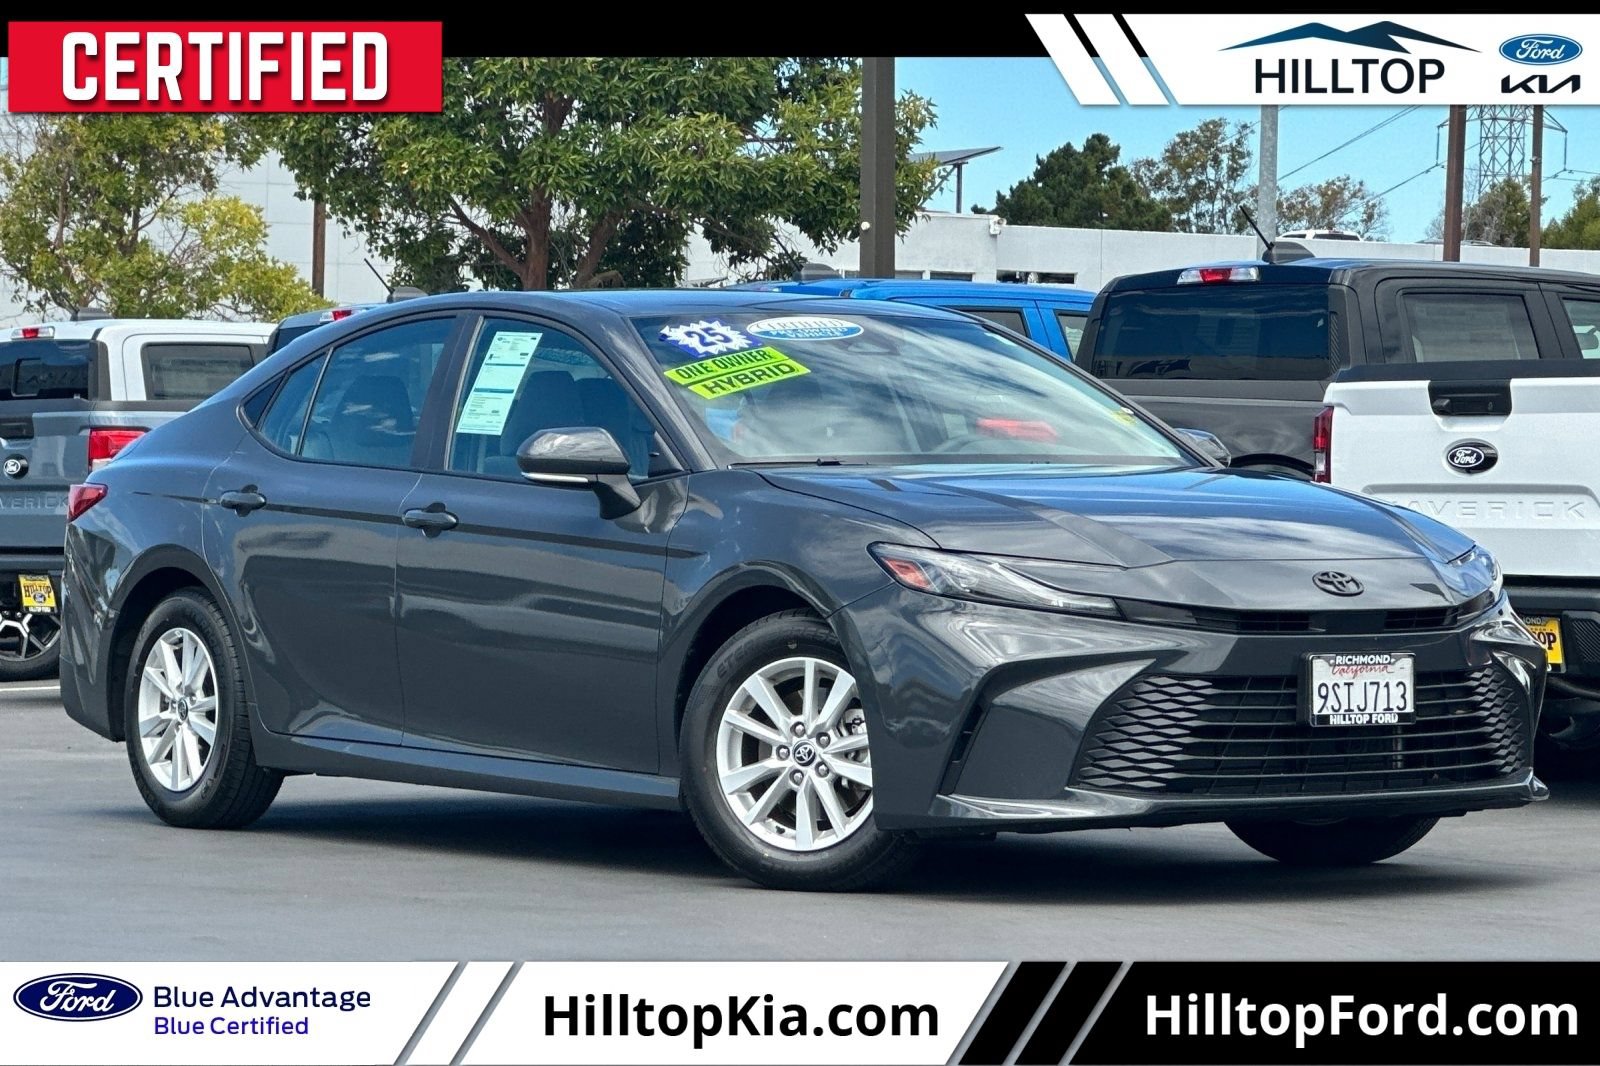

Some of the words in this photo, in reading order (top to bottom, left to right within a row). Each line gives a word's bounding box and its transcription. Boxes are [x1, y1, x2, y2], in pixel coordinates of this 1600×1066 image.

[683, 326, 734, 348] 25
[674, 363, 714, 380] ONE
[717, 350, 774, 371] OWNER
[701, 362, 798, 395] HYBRID
[1453, 449, 1477, 464] Ford
[1335, 654, 1391, 665] RICHMOND
[1331, 664, 1395, 679] California
[1317, 680, 1408, 713] 9SIJ713
[1329, 713, 1370, 725] HILLTOP
[1371, 713, 1399, 724] FORD
